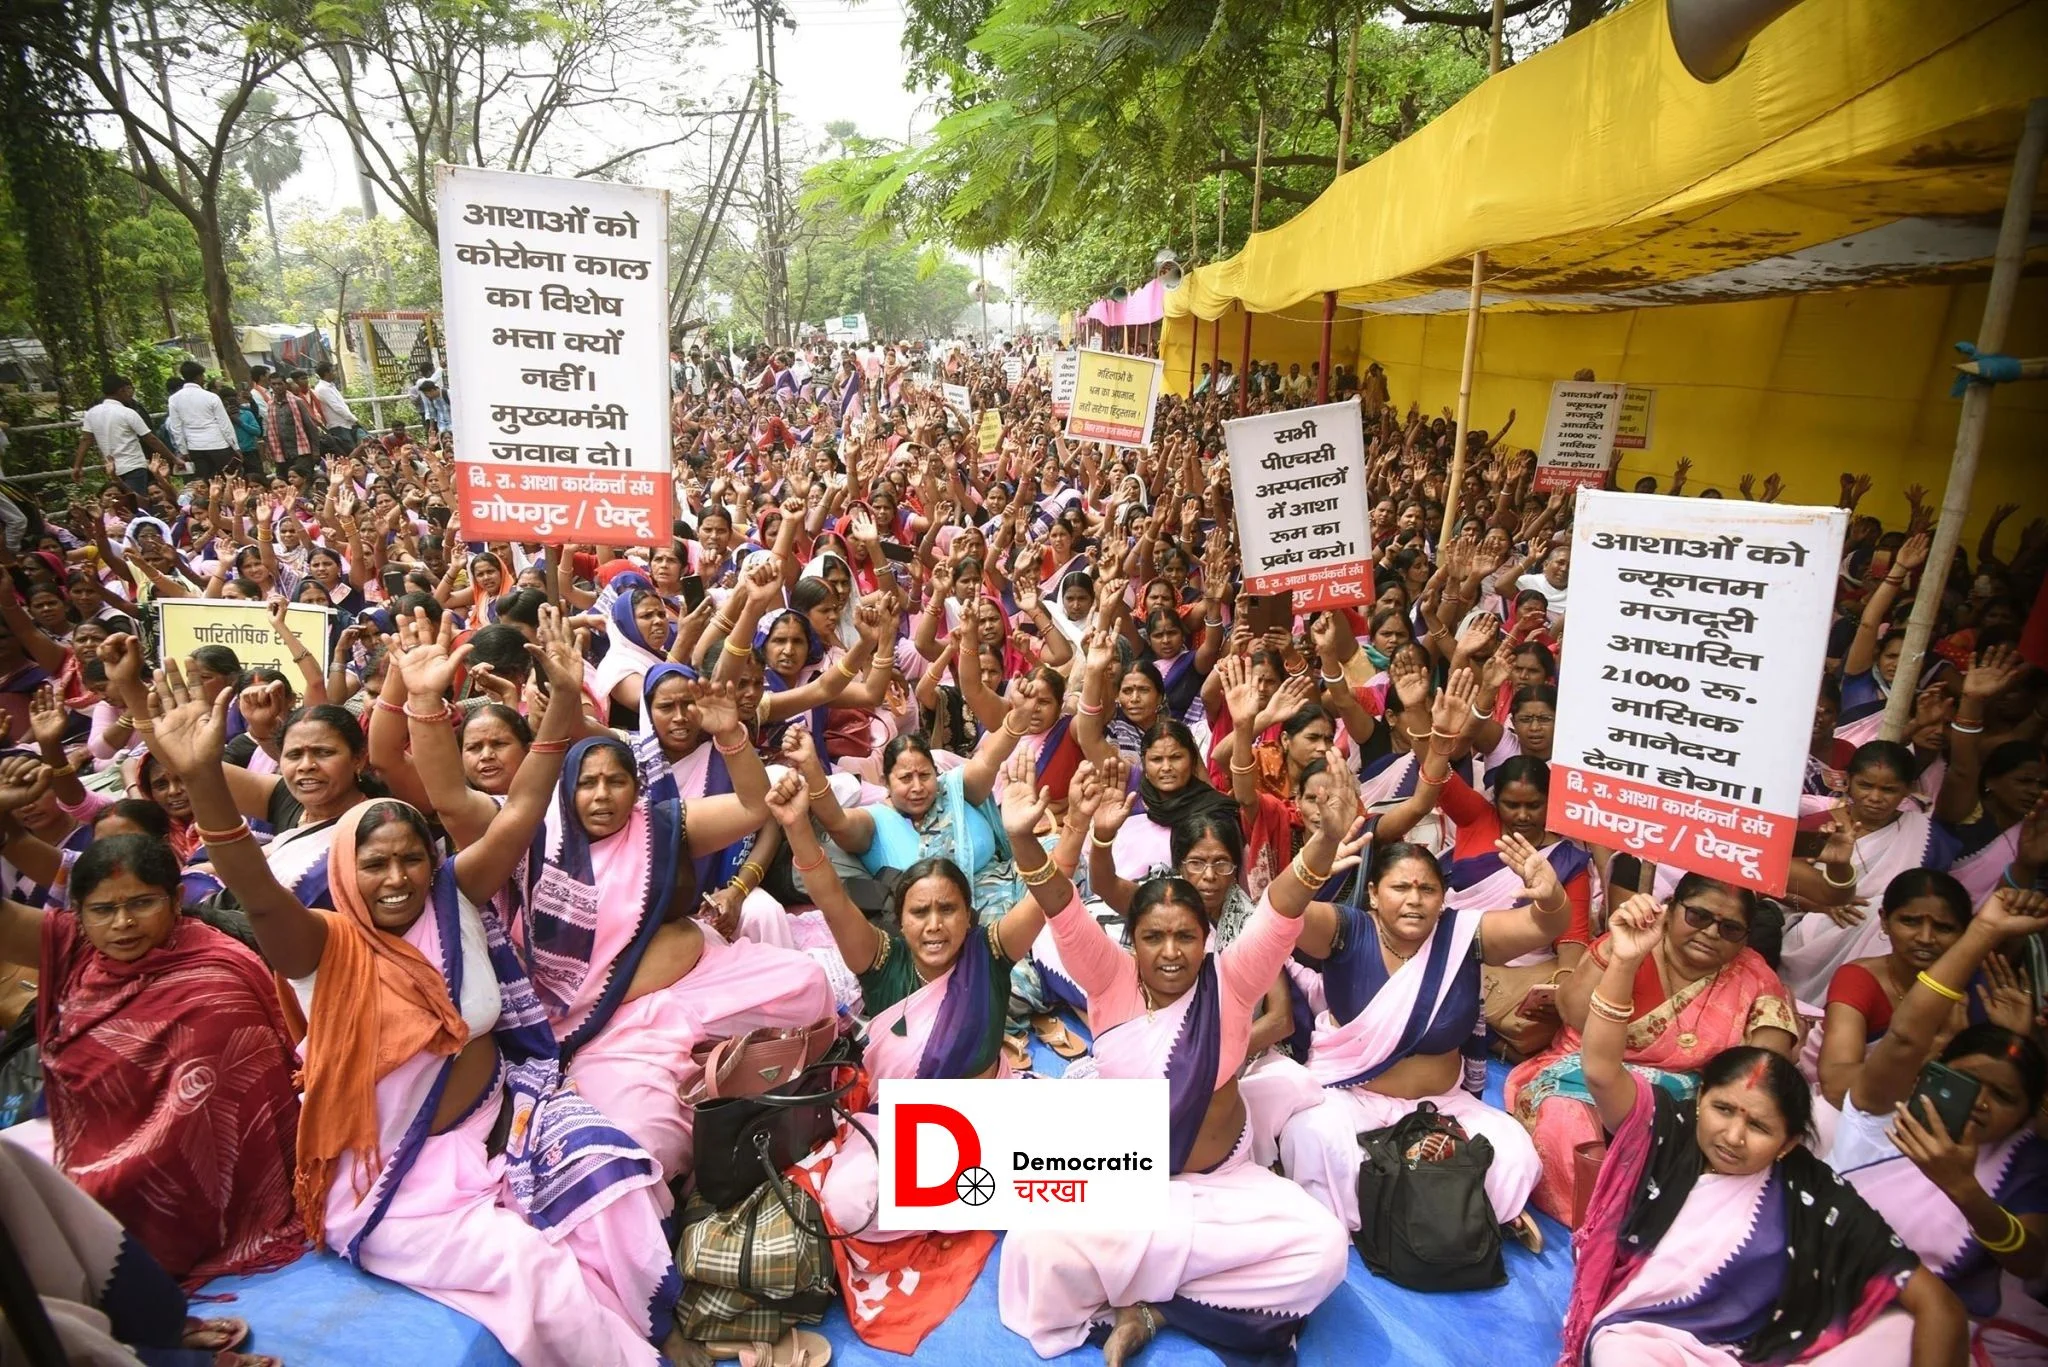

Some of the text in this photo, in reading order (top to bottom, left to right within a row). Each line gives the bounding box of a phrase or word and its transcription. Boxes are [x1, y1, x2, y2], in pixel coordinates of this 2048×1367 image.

[463, 203, 640, 239] आशाओं को
[455, 239, 651, 281] कोरोना काल
[485, 284, 624, 317] का विशेष
[492, 328, 625, 355] भत्ता क्यों
[490, 404, 628, 435] मुख्यमंत्री
[1274, 419, 1317, 444] सभी
[490, 441, 579, 465] जवाब
[1260, 443, 1336, 471] पीएचसी
[520, 474, 559, 491] आशा
[629, 475, 655, 496] संघ
[1255, 466, 1350, 498] अस्पतालों
[471, 493, 655, 538] गोपगुट / ऐक्टू
[1267, 497, 1339, 520] में आशा
[1269, 521, 1340, 544] रूम का
[1260, 547, 1303, 570] प्रबंध
[1591, 532, 1810, 567] आशाओं को
[1317, 584, 1324, 602] /
[1328, 580, 1366, 599] ऐक्टू
[1618, 567, 1769, 599] न्यूनतम
[193, 623, 270, 644] पारितोषिक
[1620, 600, 1758, 639] मजदूरी
[1606, 634, 1764, 672] आधारित
[1600, 665, 1690, 693] 21000
[1612, 697, 1744, 734] मासिक
[1607, 727, 1741, 767] मानेदय
[1582, 748, 1649, 778] देना
[1617, 788, 1659, 811] आशा
[1741, 814, 1775, 838] संघ
[1565, 800, 1763, 881] गोपगुट / ऐक्टू
